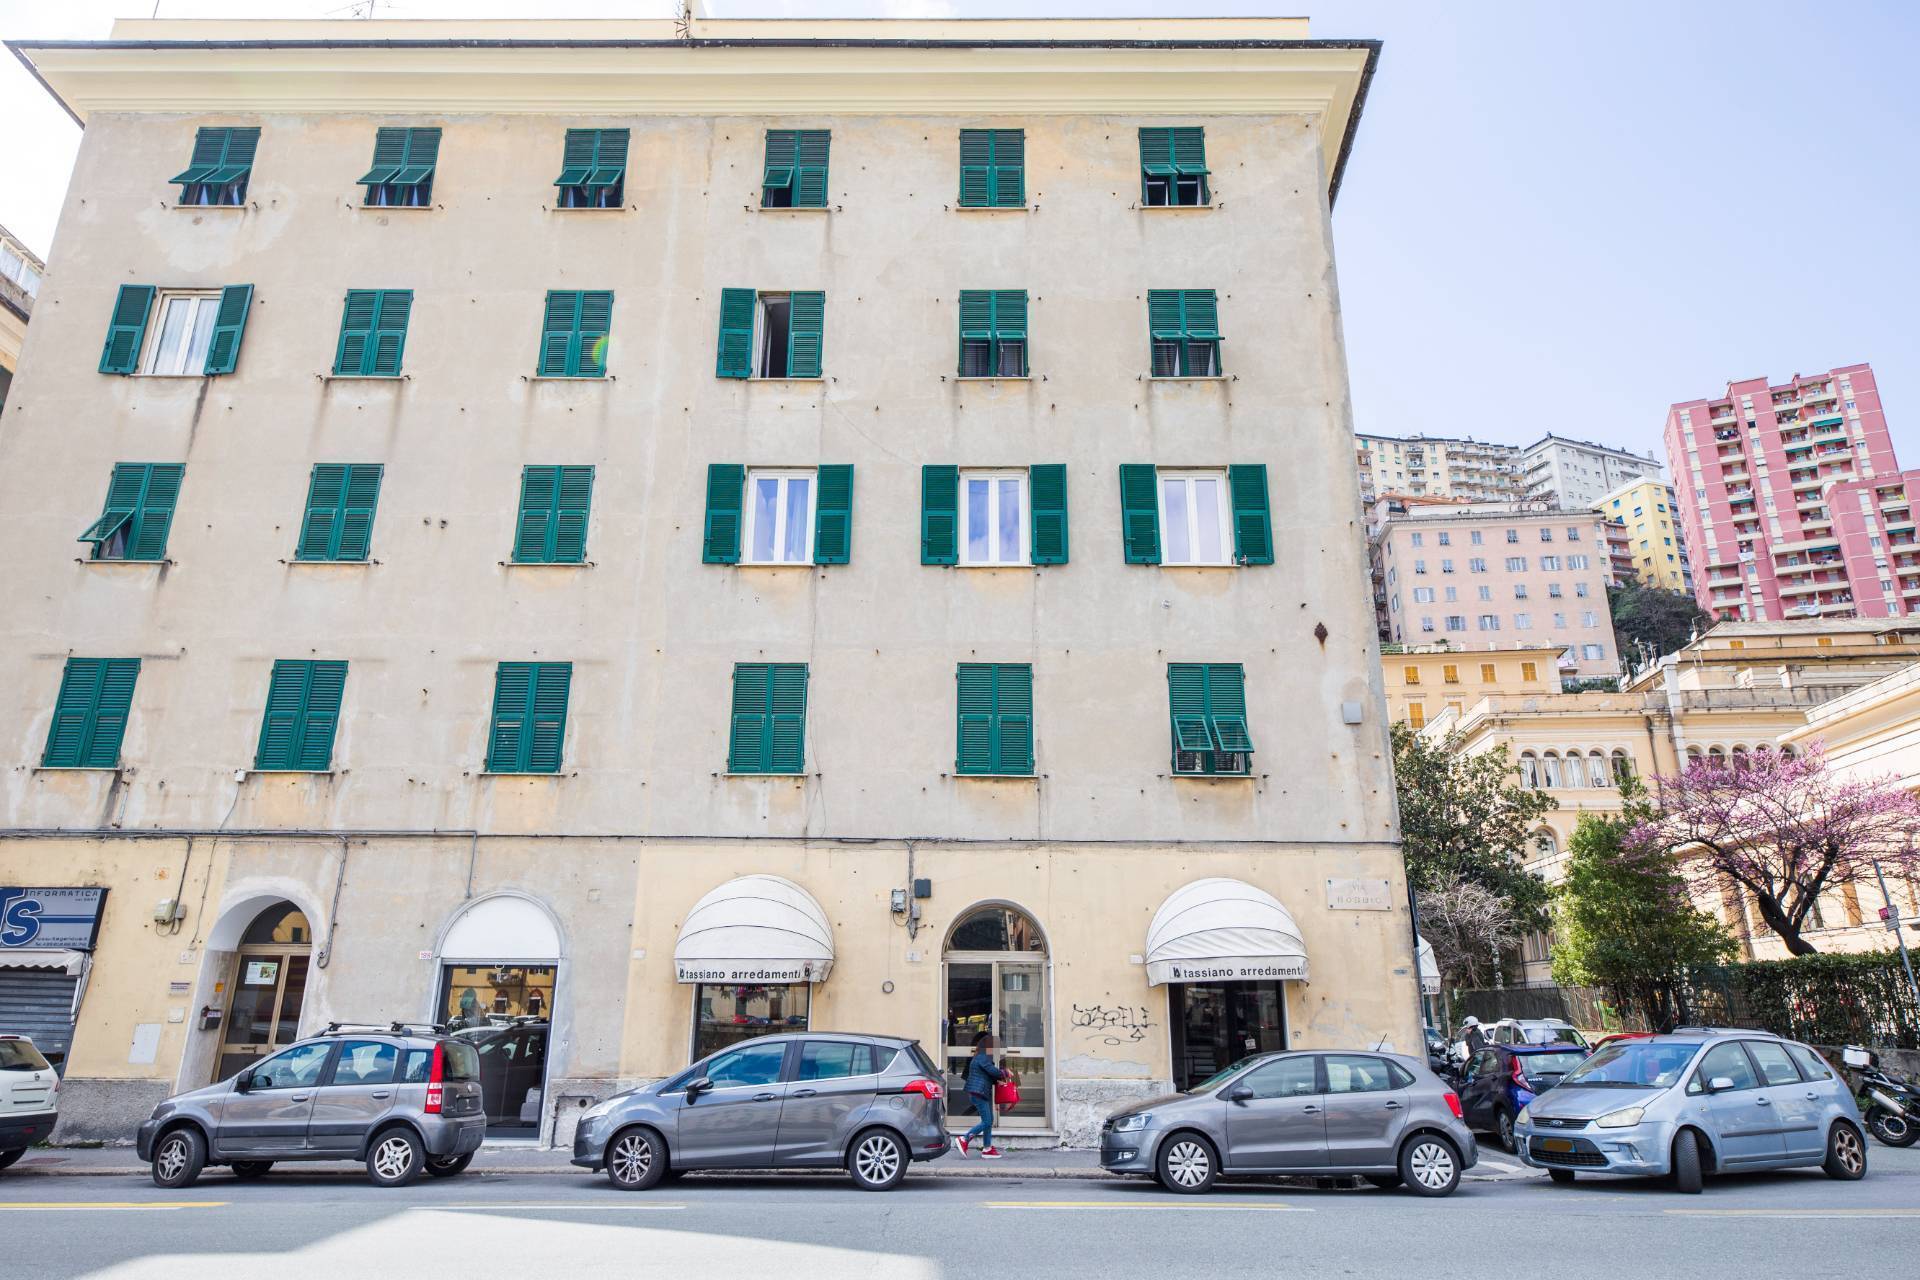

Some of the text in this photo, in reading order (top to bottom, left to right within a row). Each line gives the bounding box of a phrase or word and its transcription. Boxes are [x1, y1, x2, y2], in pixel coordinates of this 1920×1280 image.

[686, 968, 725, 979] tassiano
[731, 968, 801, 979] arredamenti
[1183, 967, 1234, 978] tassiano
[1240, 966, 1303, 977] arredamenti
